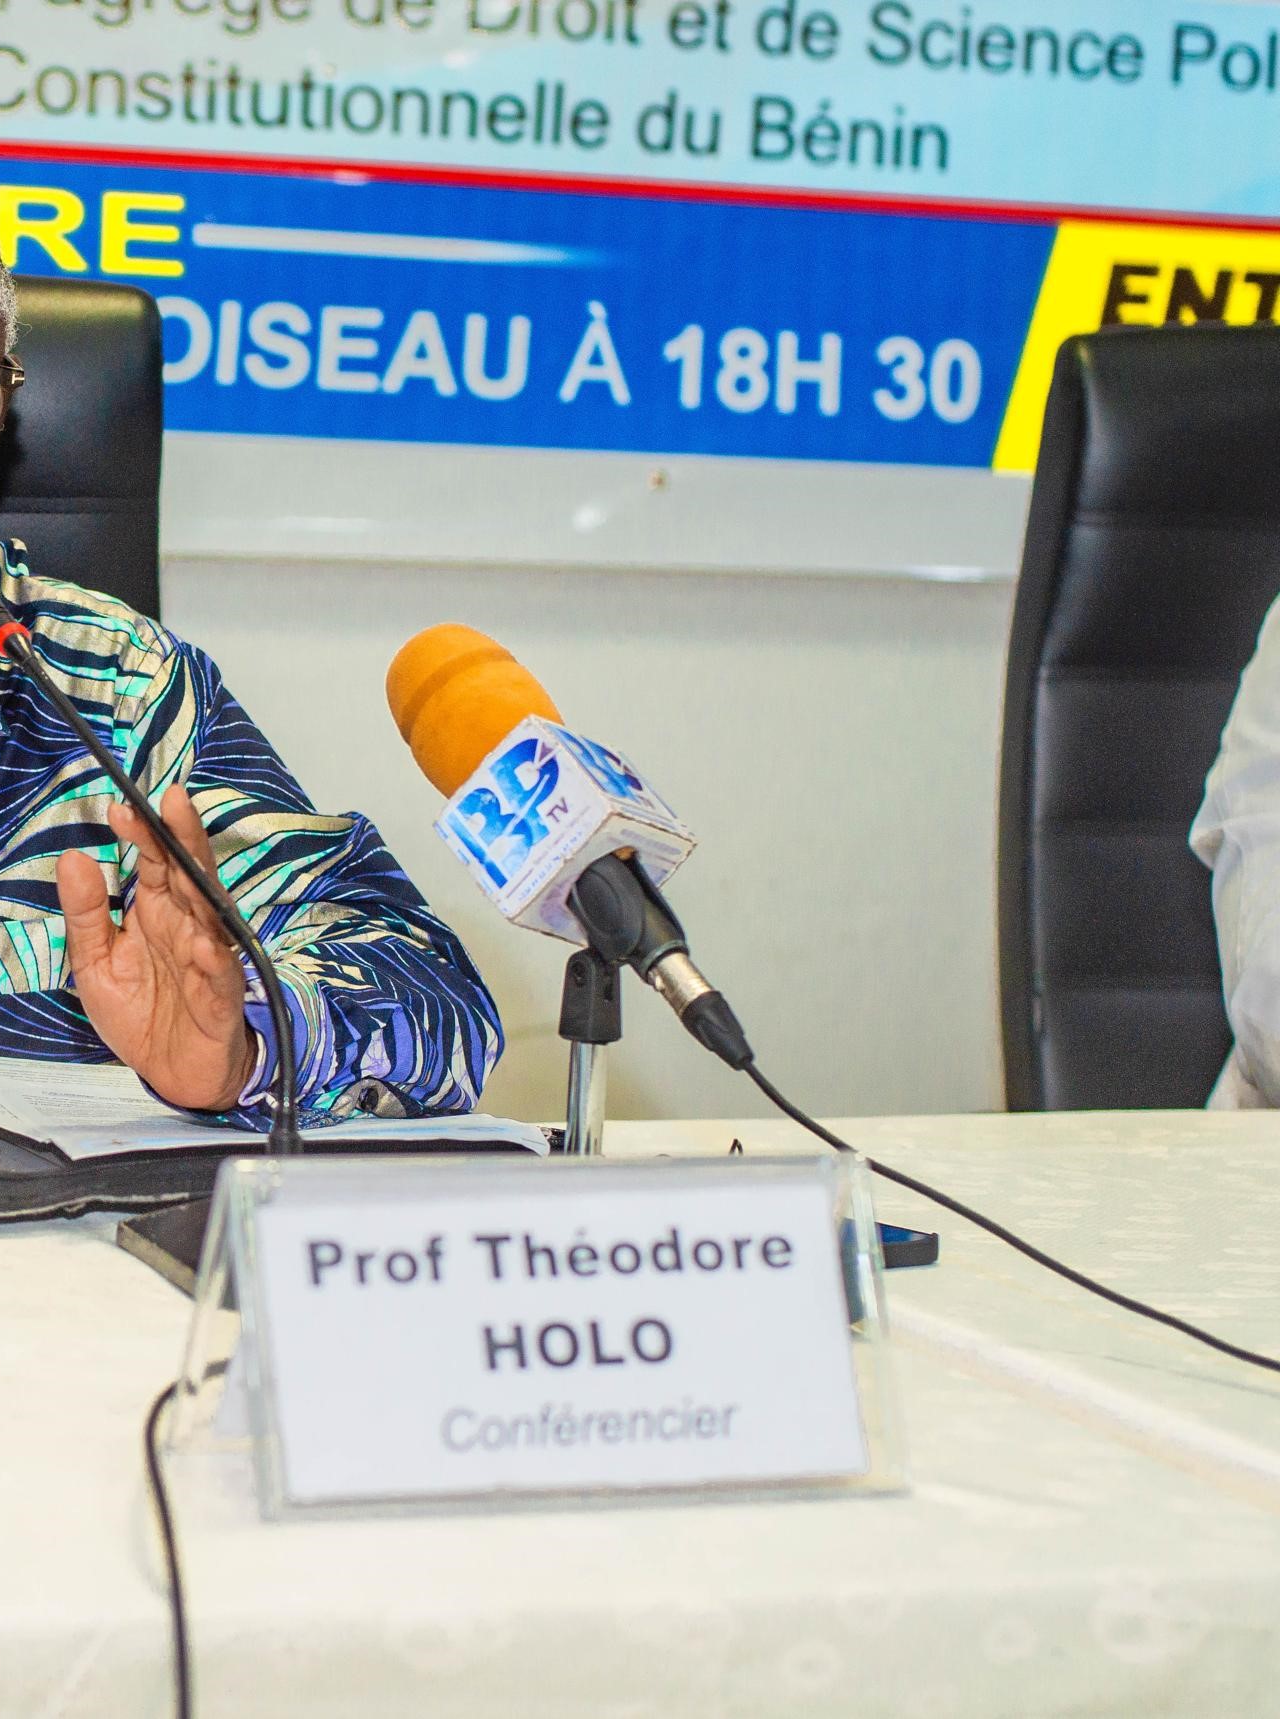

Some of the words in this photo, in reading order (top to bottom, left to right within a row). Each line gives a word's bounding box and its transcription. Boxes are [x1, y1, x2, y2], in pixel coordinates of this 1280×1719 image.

[668, 0, 730, 52] et
[756, 0, 839, 57] de
[868, 0, 1144, 83] Science
[1172, 22, 1280, 91] Pol
[636, 90, 721, 156] du
[751, 94, 950, 171] Bénin
[558, 300, 632, 406] À
[663, 324, 842, 416] 18H
[873, 336, 982, 424] 30
[306, 1233, 445, 1287] Prof
[474, 1225, 796, 1281] Théodore
[481, 1316, 674, 1371] HOLO
[439, 1399, 739, 1453] Conférencier
